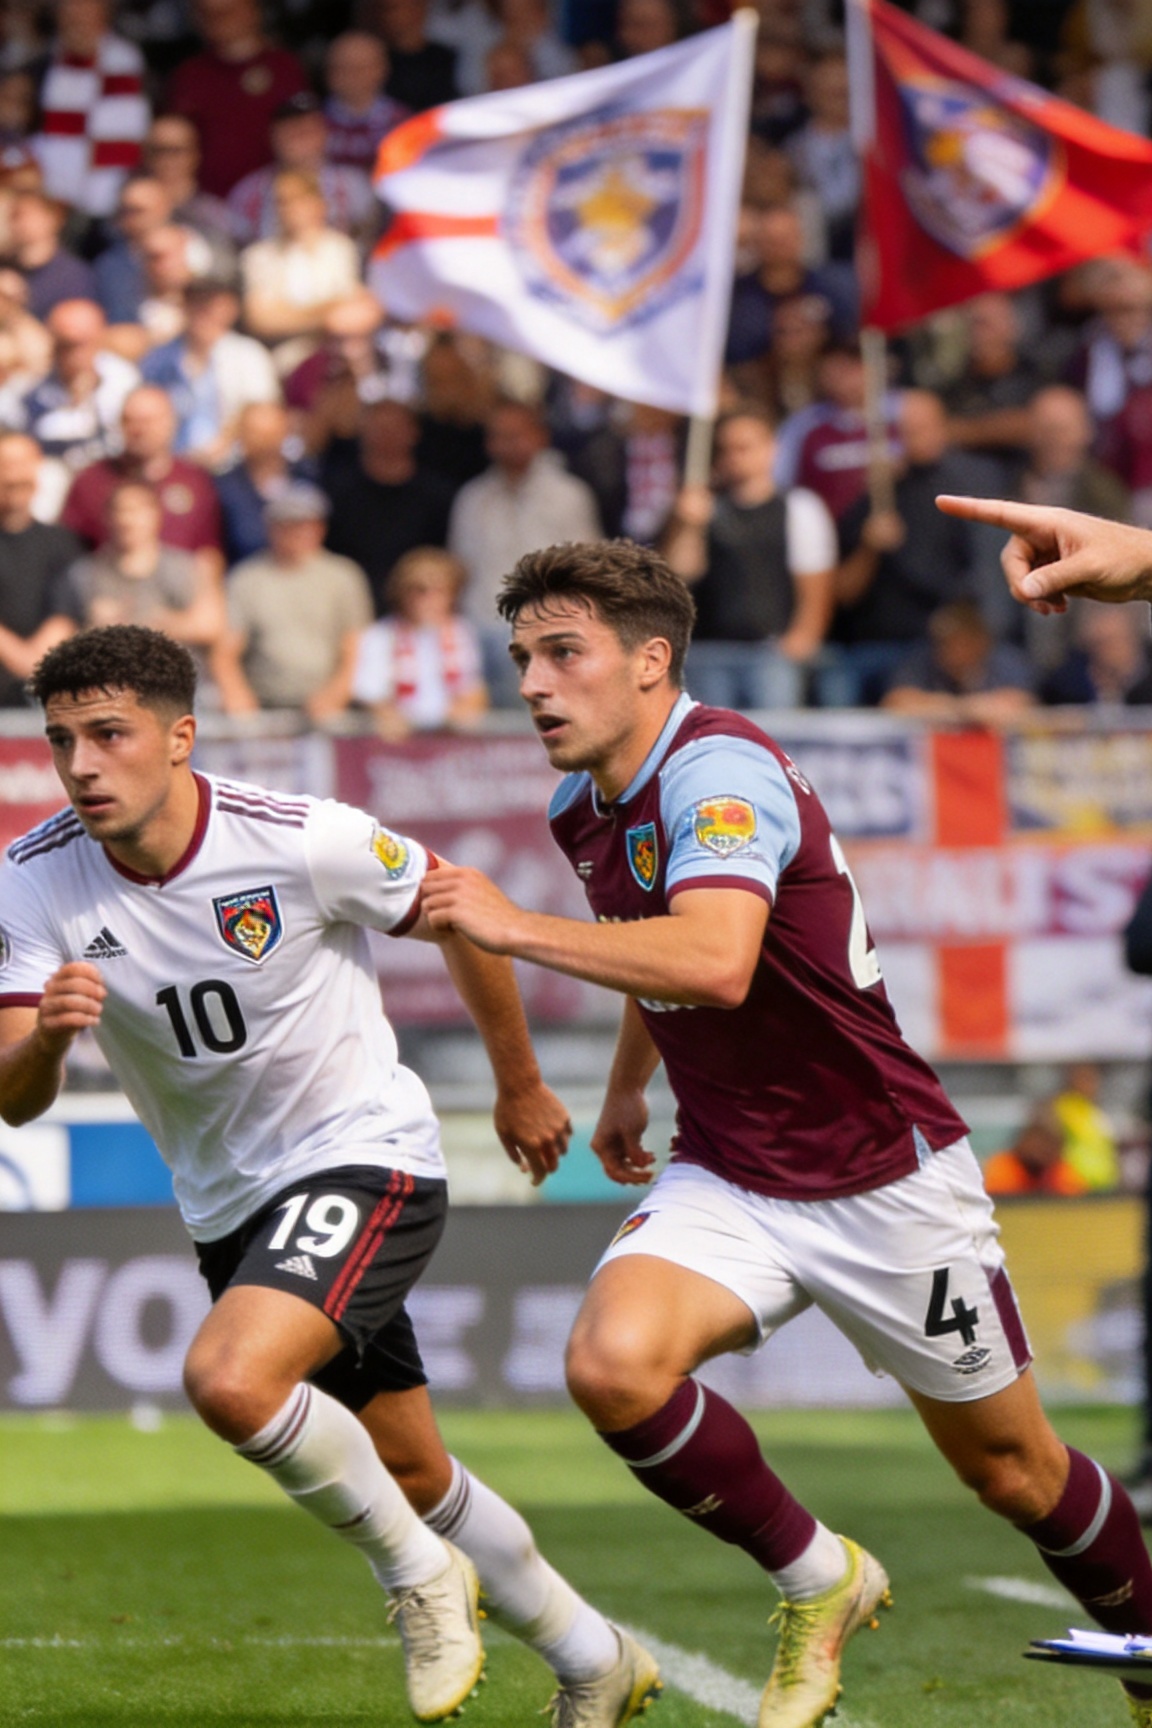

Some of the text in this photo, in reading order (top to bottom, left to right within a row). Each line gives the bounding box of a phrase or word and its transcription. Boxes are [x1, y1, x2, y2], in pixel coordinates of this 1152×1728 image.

[156, 979, 247, 1057] 10
[268, 1193, 358, 1257] 19
[925, 1266, 979, 1346] 4
